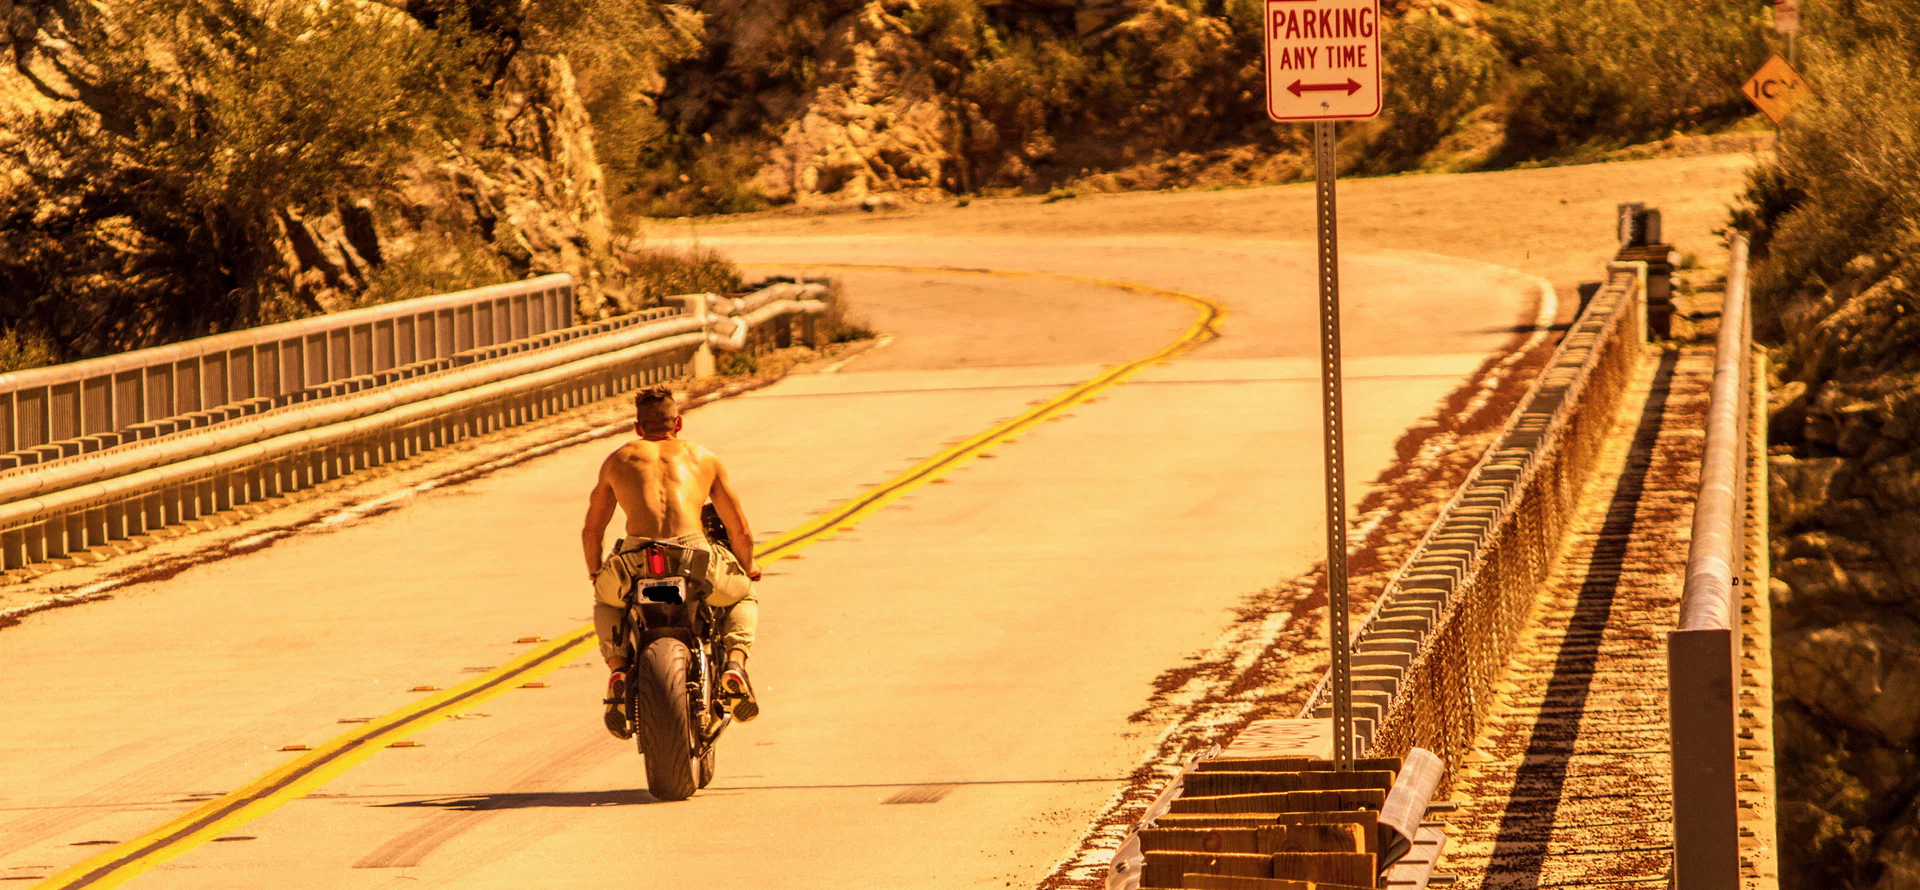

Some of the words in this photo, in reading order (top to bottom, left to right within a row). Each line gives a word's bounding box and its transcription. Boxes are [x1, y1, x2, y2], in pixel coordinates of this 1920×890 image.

[1272, 7, 1373, 39] PARKING
[1280, 46, 1318, 70] ANY
[1325, 44, 1367, 69] TIME
